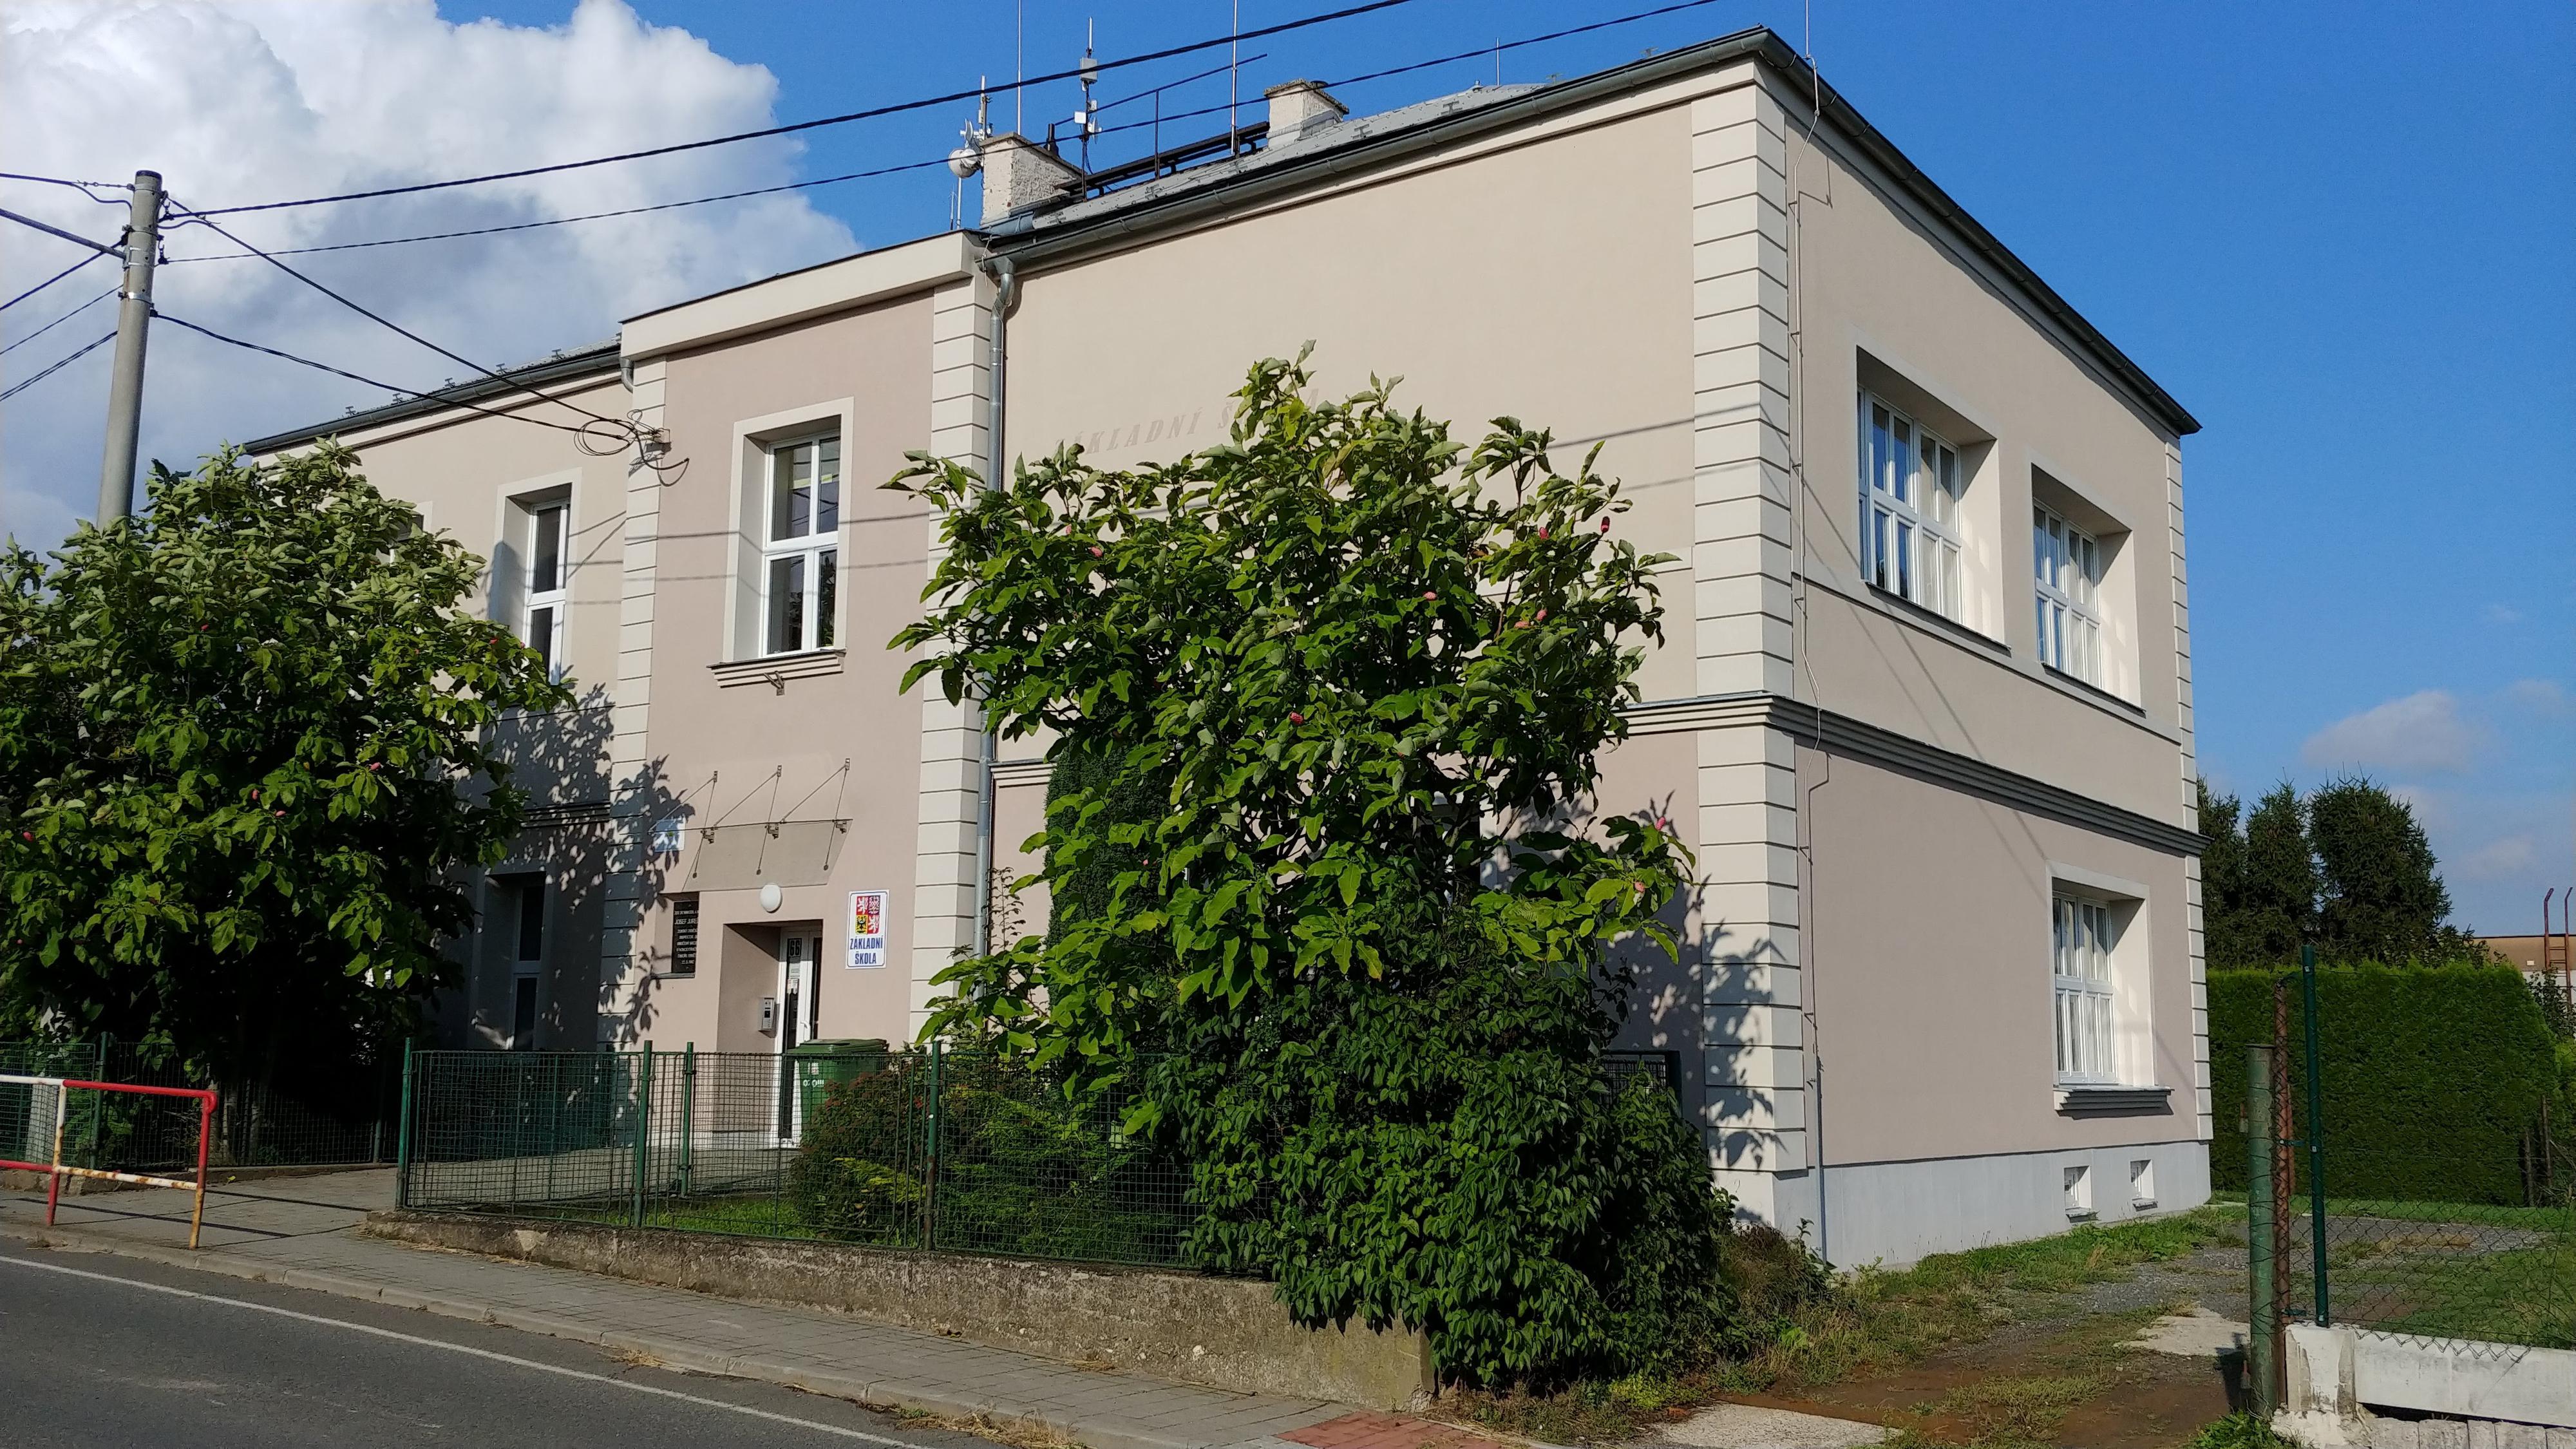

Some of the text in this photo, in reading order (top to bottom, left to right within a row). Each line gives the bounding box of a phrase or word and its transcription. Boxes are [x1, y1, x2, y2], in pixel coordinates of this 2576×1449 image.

[1054, 406, 1203, 454] KLADNÍ
[790, 940, 800, 956] 66
[849, 935, 883, 950] ZÁKLADNÍ
[855, 951, 876, 965] ŠKOLA
